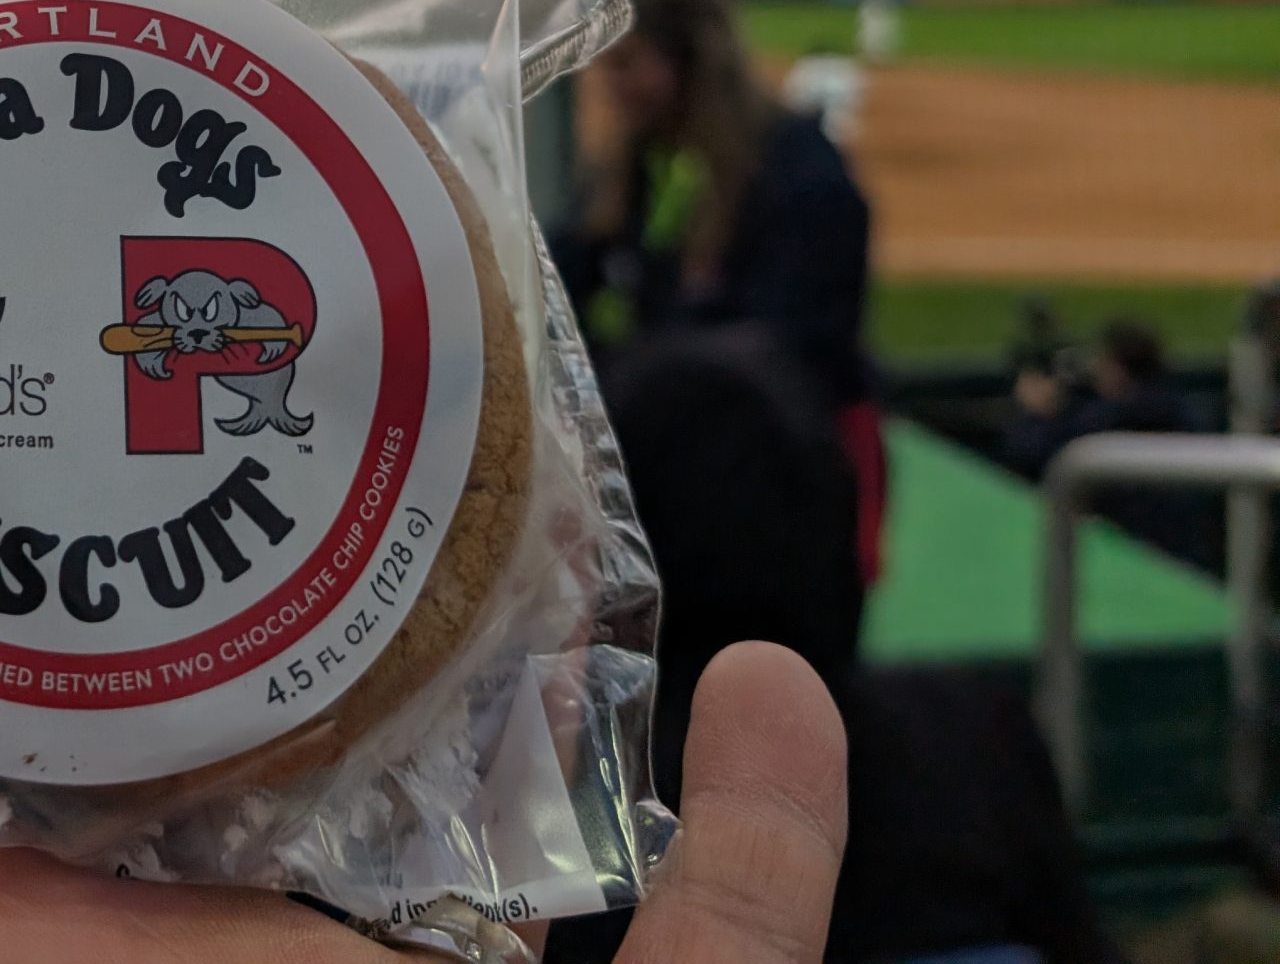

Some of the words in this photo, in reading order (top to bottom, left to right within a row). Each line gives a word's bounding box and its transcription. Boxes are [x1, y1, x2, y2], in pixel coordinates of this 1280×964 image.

[60, 52, 282, 218] Dogs
[41, 668, 153, 694] BETWEEN
[157, 651, 214, 685] TWO
[218, 567, 337, 664] CHOCOLATE
[332, 521, 365, 570] CHIP
[358, 425, 404, 521] COOKIES
[266, 658, 315, 706] 4.5
[316, 645, 347, 674] FL
[344, 609, 381, 647] OZ.
[370, 540, 414, 607] (128
[406, 506, 434, 540] G)
